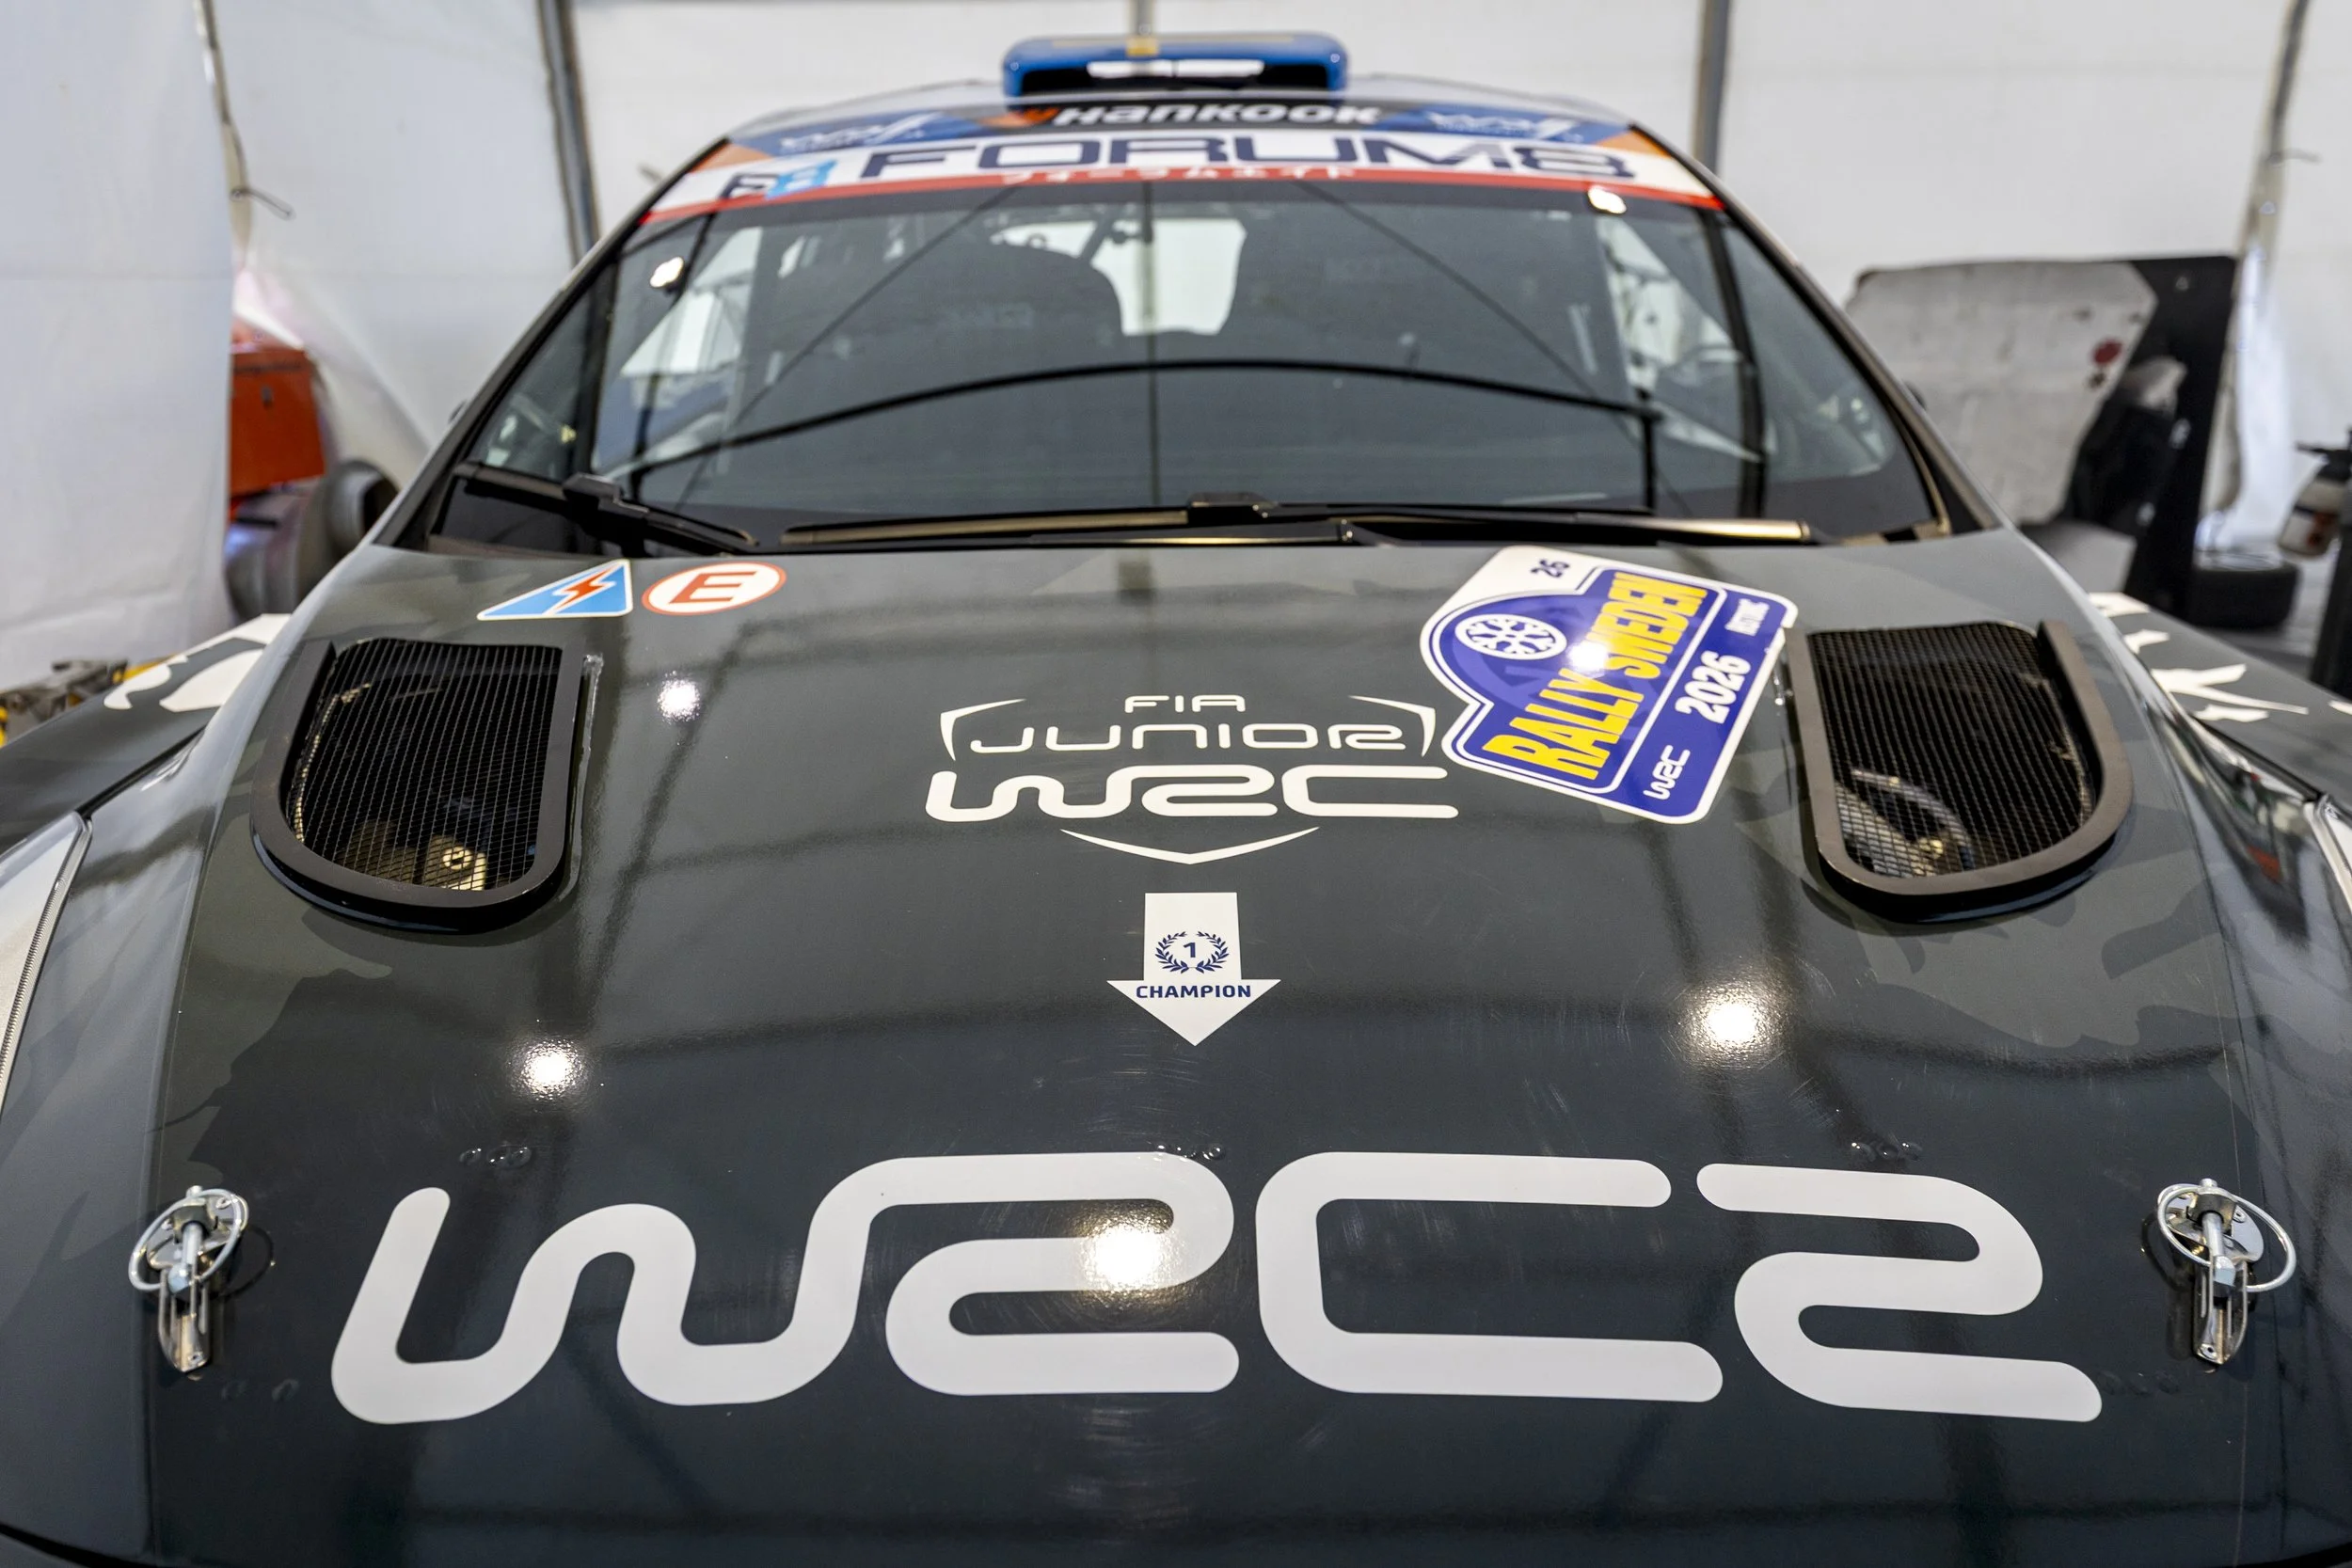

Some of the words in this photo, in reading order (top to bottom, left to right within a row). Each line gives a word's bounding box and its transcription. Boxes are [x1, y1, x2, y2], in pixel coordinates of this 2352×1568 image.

[860, 135, 1635, 180] FORUM8
[669, 569, 756, 605] E
[1483, 667, 1645, 781] RALLY
[1573, 571, 1708, 679] SWEDEN
[1675, 650, 1752, 724] 2026
[1125, 694, 1247, 713] FIA
[969, 722, 1406, 753] JUNIOR
[925, 764, 1459, 822] WRC
[1644, 745, 1691, 800] WRC
[1183, 942, 1196, 958] 1
[1136, 985, 1251, 999] CHAMPION
[331, 1150, 2103, 1424] WRC2
